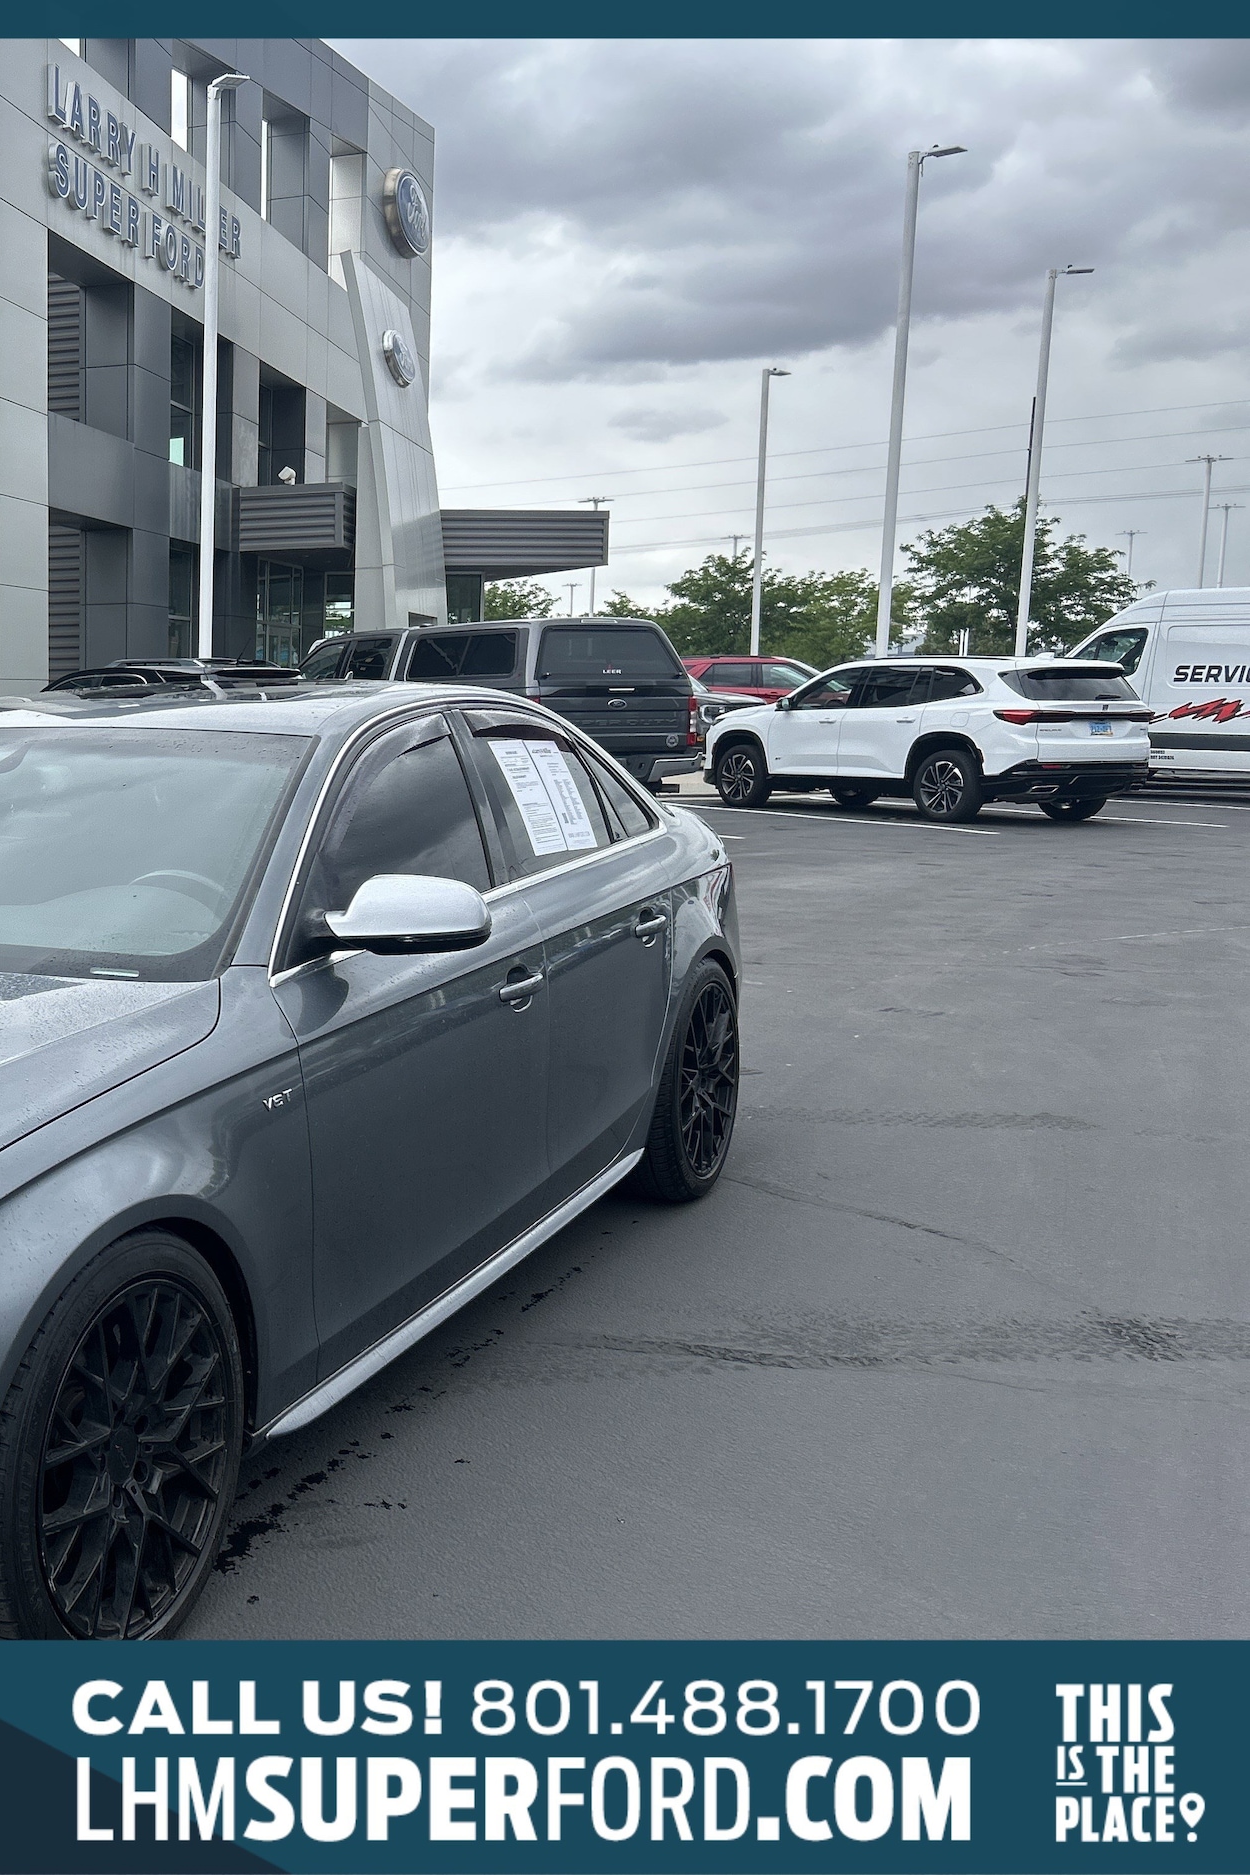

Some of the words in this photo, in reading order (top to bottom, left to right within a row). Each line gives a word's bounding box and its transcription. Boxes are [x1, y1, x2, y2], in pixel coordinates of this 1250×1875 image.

[49, 63, 136, 174] LARRY
[141, 143, 159, 196] H
[165, 163, 241, 259] MILER
[49, 142, 139, 247] SUPER
[145, 211, 205, 289] FORD
[1174, 665, 1250, 683] SERVI
